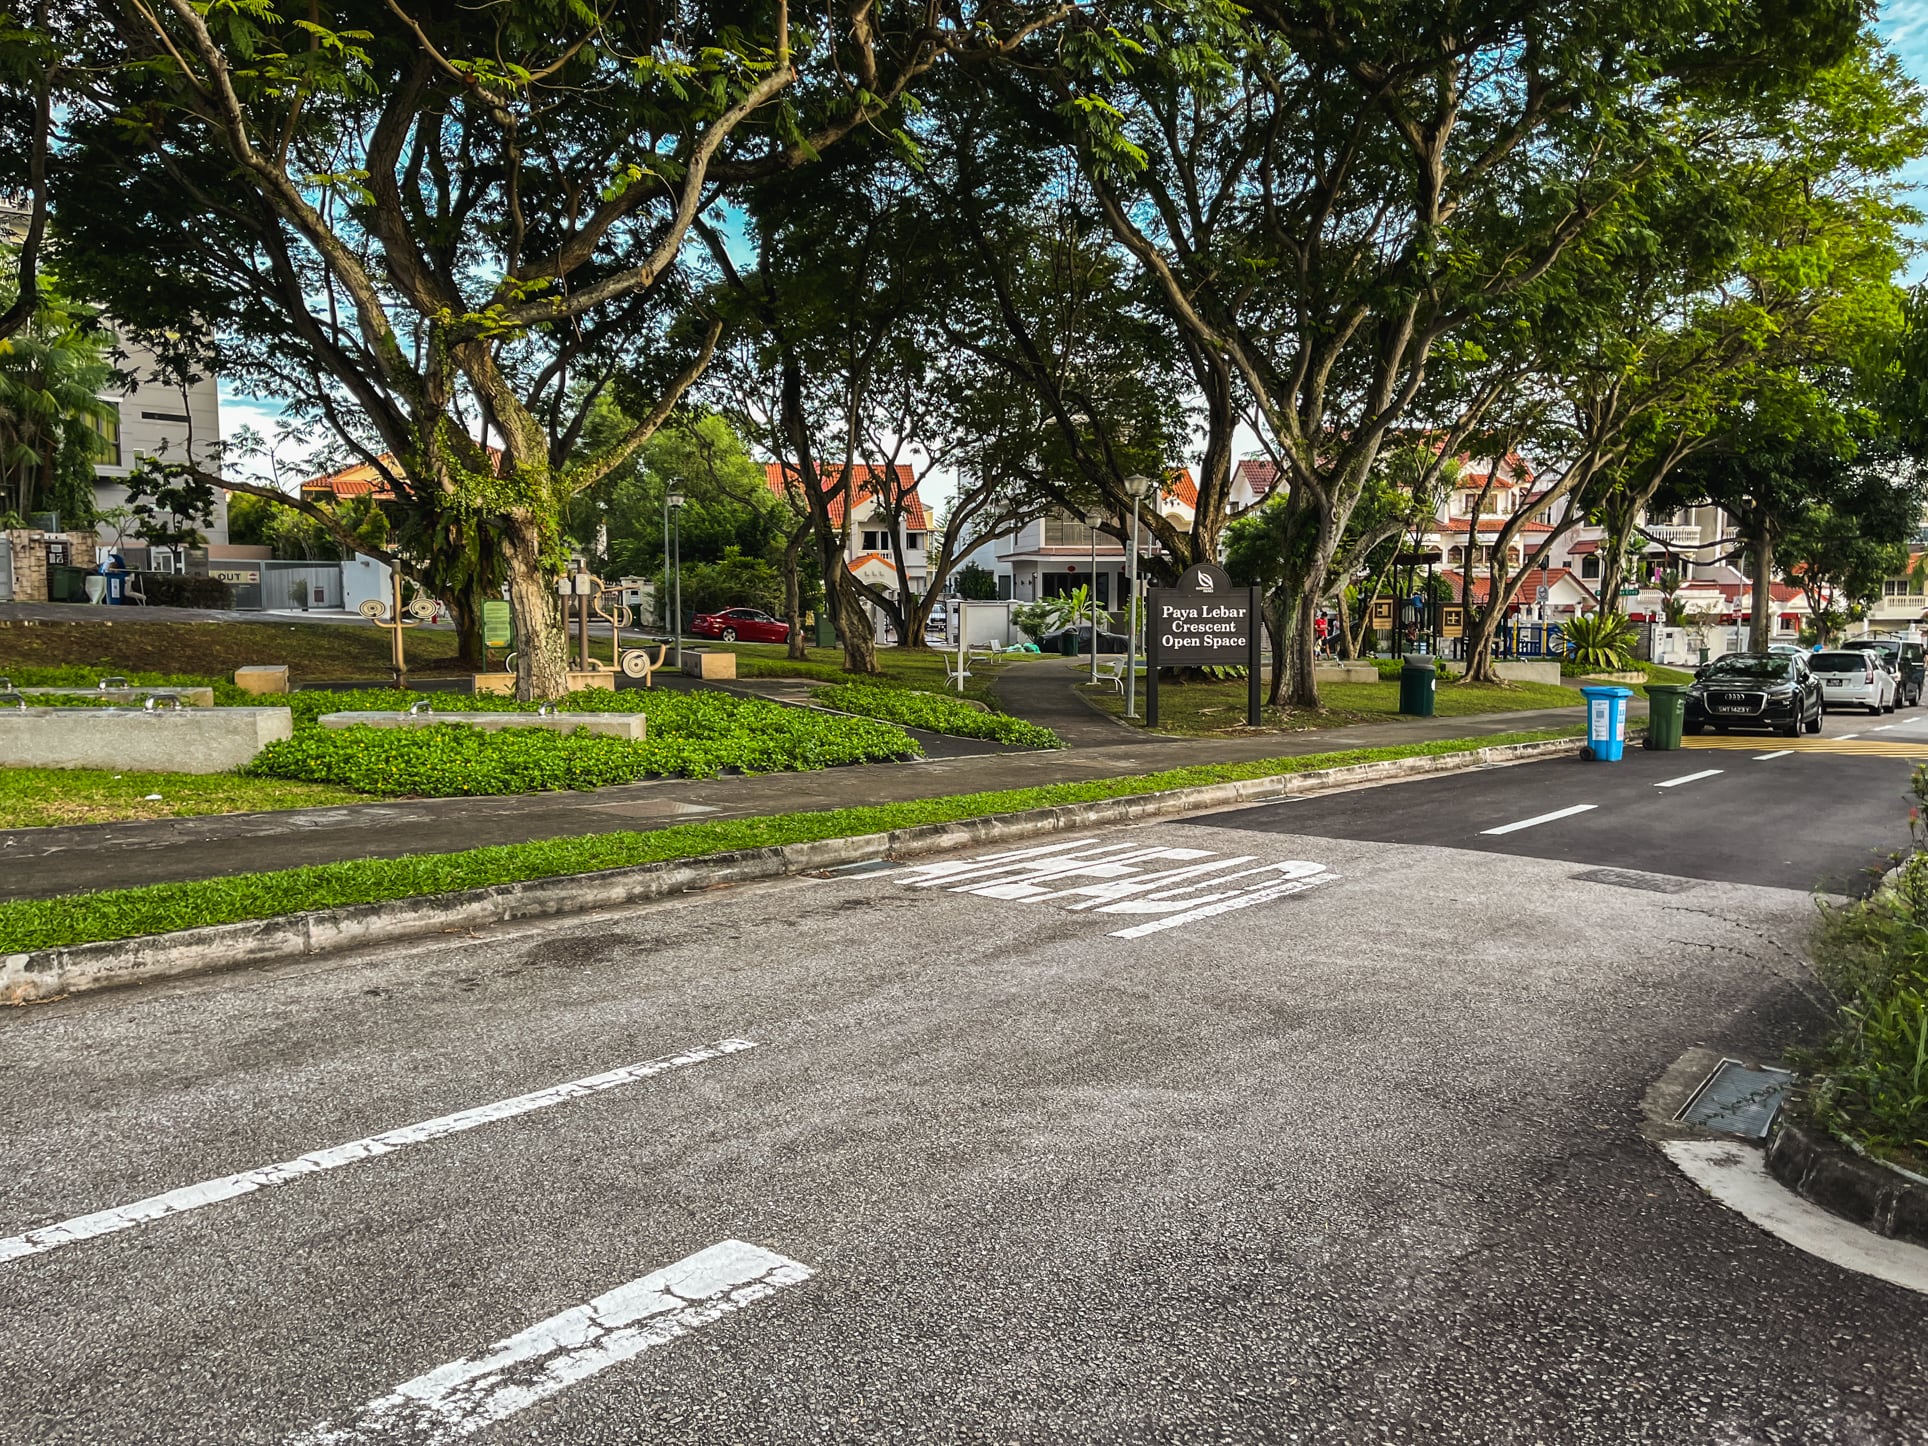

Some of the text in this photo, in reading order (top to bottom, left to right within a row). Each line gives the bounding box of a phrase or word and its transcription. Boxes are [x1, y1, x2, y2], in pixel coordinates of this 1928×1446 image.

[218, 573, 241, 581] OUT
[1162, 605, 1247, 621] Paya Lebar
[1172, 620, 1237, 633] Crescent
[1162, 634, 1247, 650] Open Space
[893, 838, 1328, 914] AHEAD
